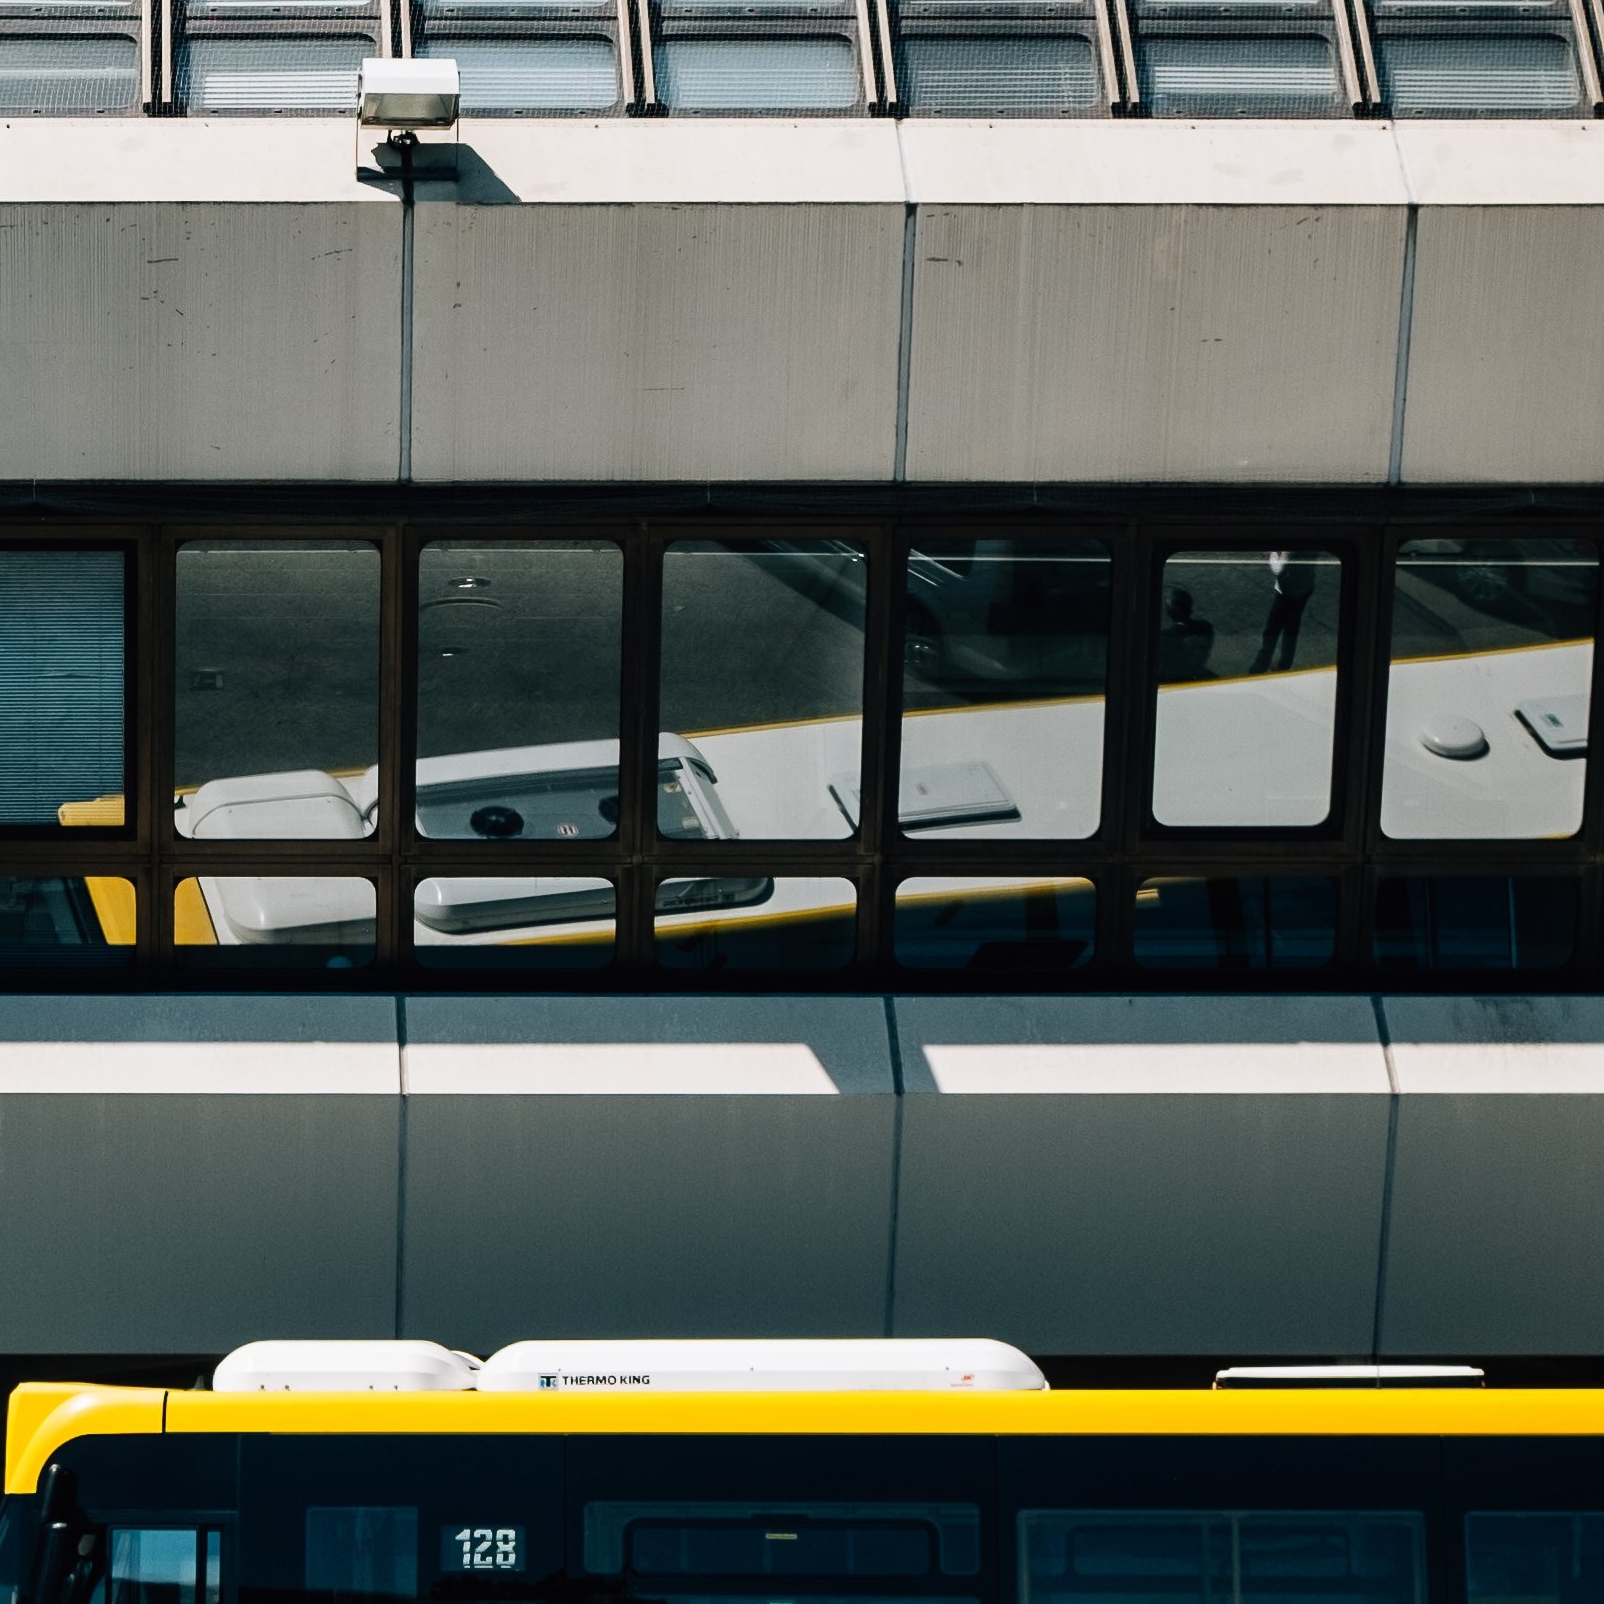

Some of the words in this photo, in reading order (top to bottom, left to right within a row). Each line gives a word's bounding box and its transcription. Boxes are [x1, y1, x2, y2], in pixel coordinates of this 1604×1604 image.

[562, 1375, 617, 1386] THERMO
[620, 1375, 650, 1385] KING
[455, 1529, 516, 1569] 128
